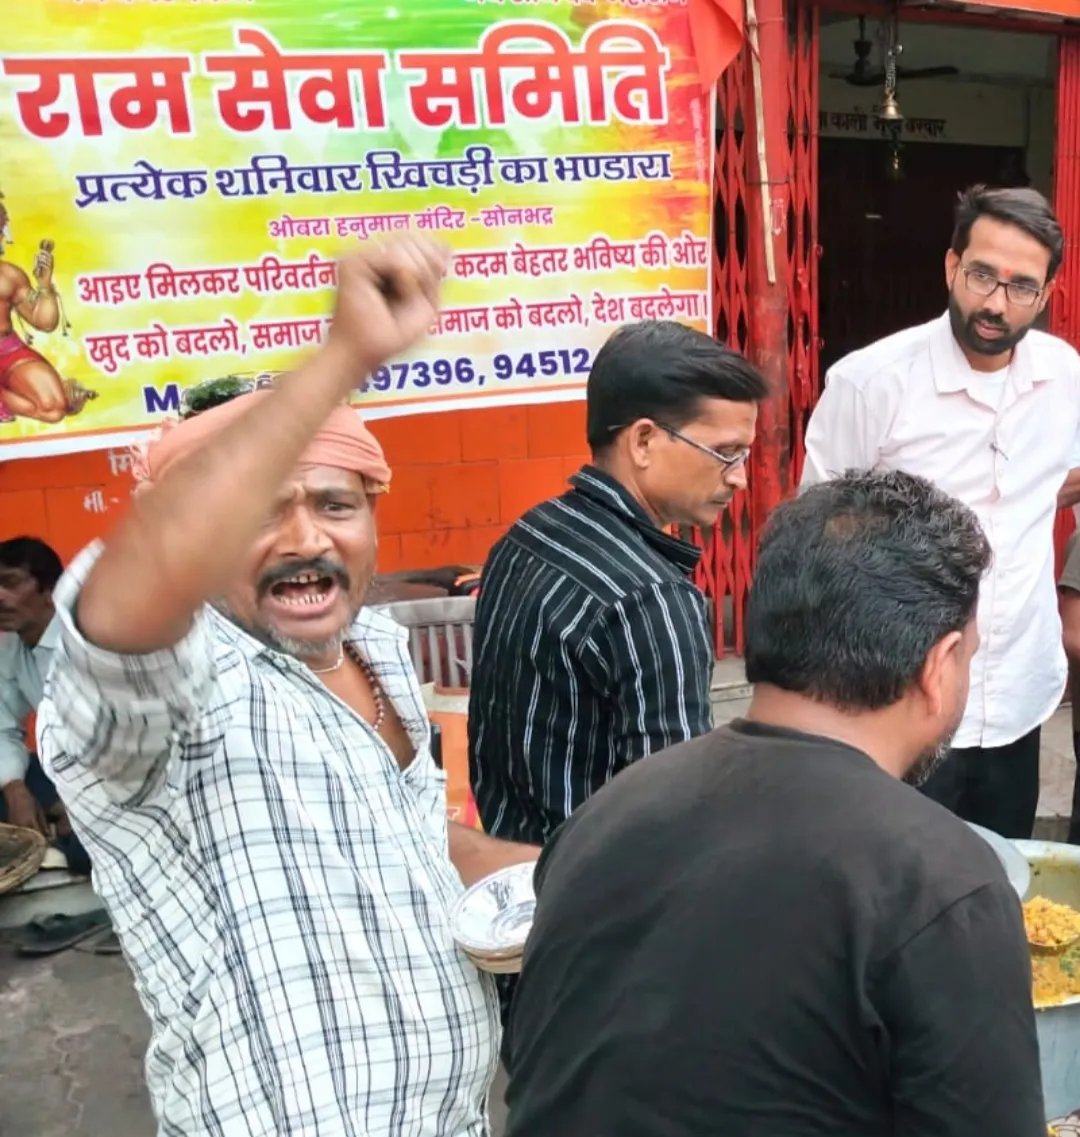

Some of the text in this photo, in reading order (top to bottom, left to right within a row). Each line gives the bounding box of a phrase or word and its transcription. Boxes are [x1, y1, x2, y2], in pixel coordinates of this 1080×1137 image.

[2, 23, 667, 138] राम सेवा समिति
[75, 146, 673, 208] प्रत्येक शनिवार खिचड़ी का भण्डारा
[269, 214, 330, 239] ओबरा
[336, 214, 410, 240] हनुमान
[416, 206, 466, 230] मंदिर
[78, 234, 707, 305] आइए मिलकर परिवर्तन कदम बेहतर भविष्य की ओर
[86, 333, 131, 373] खुद
[133, 323, 169, 358] को
[173, 318, 247, 356] बदलो,
[250, 319, 322, 350] समाज
[493, 297, 523, 329] को
[526, 294, 590, 328] बदलो,
[592, 291, 625, 324] देश
[359, 349, 591, 393] 97396, 94512
